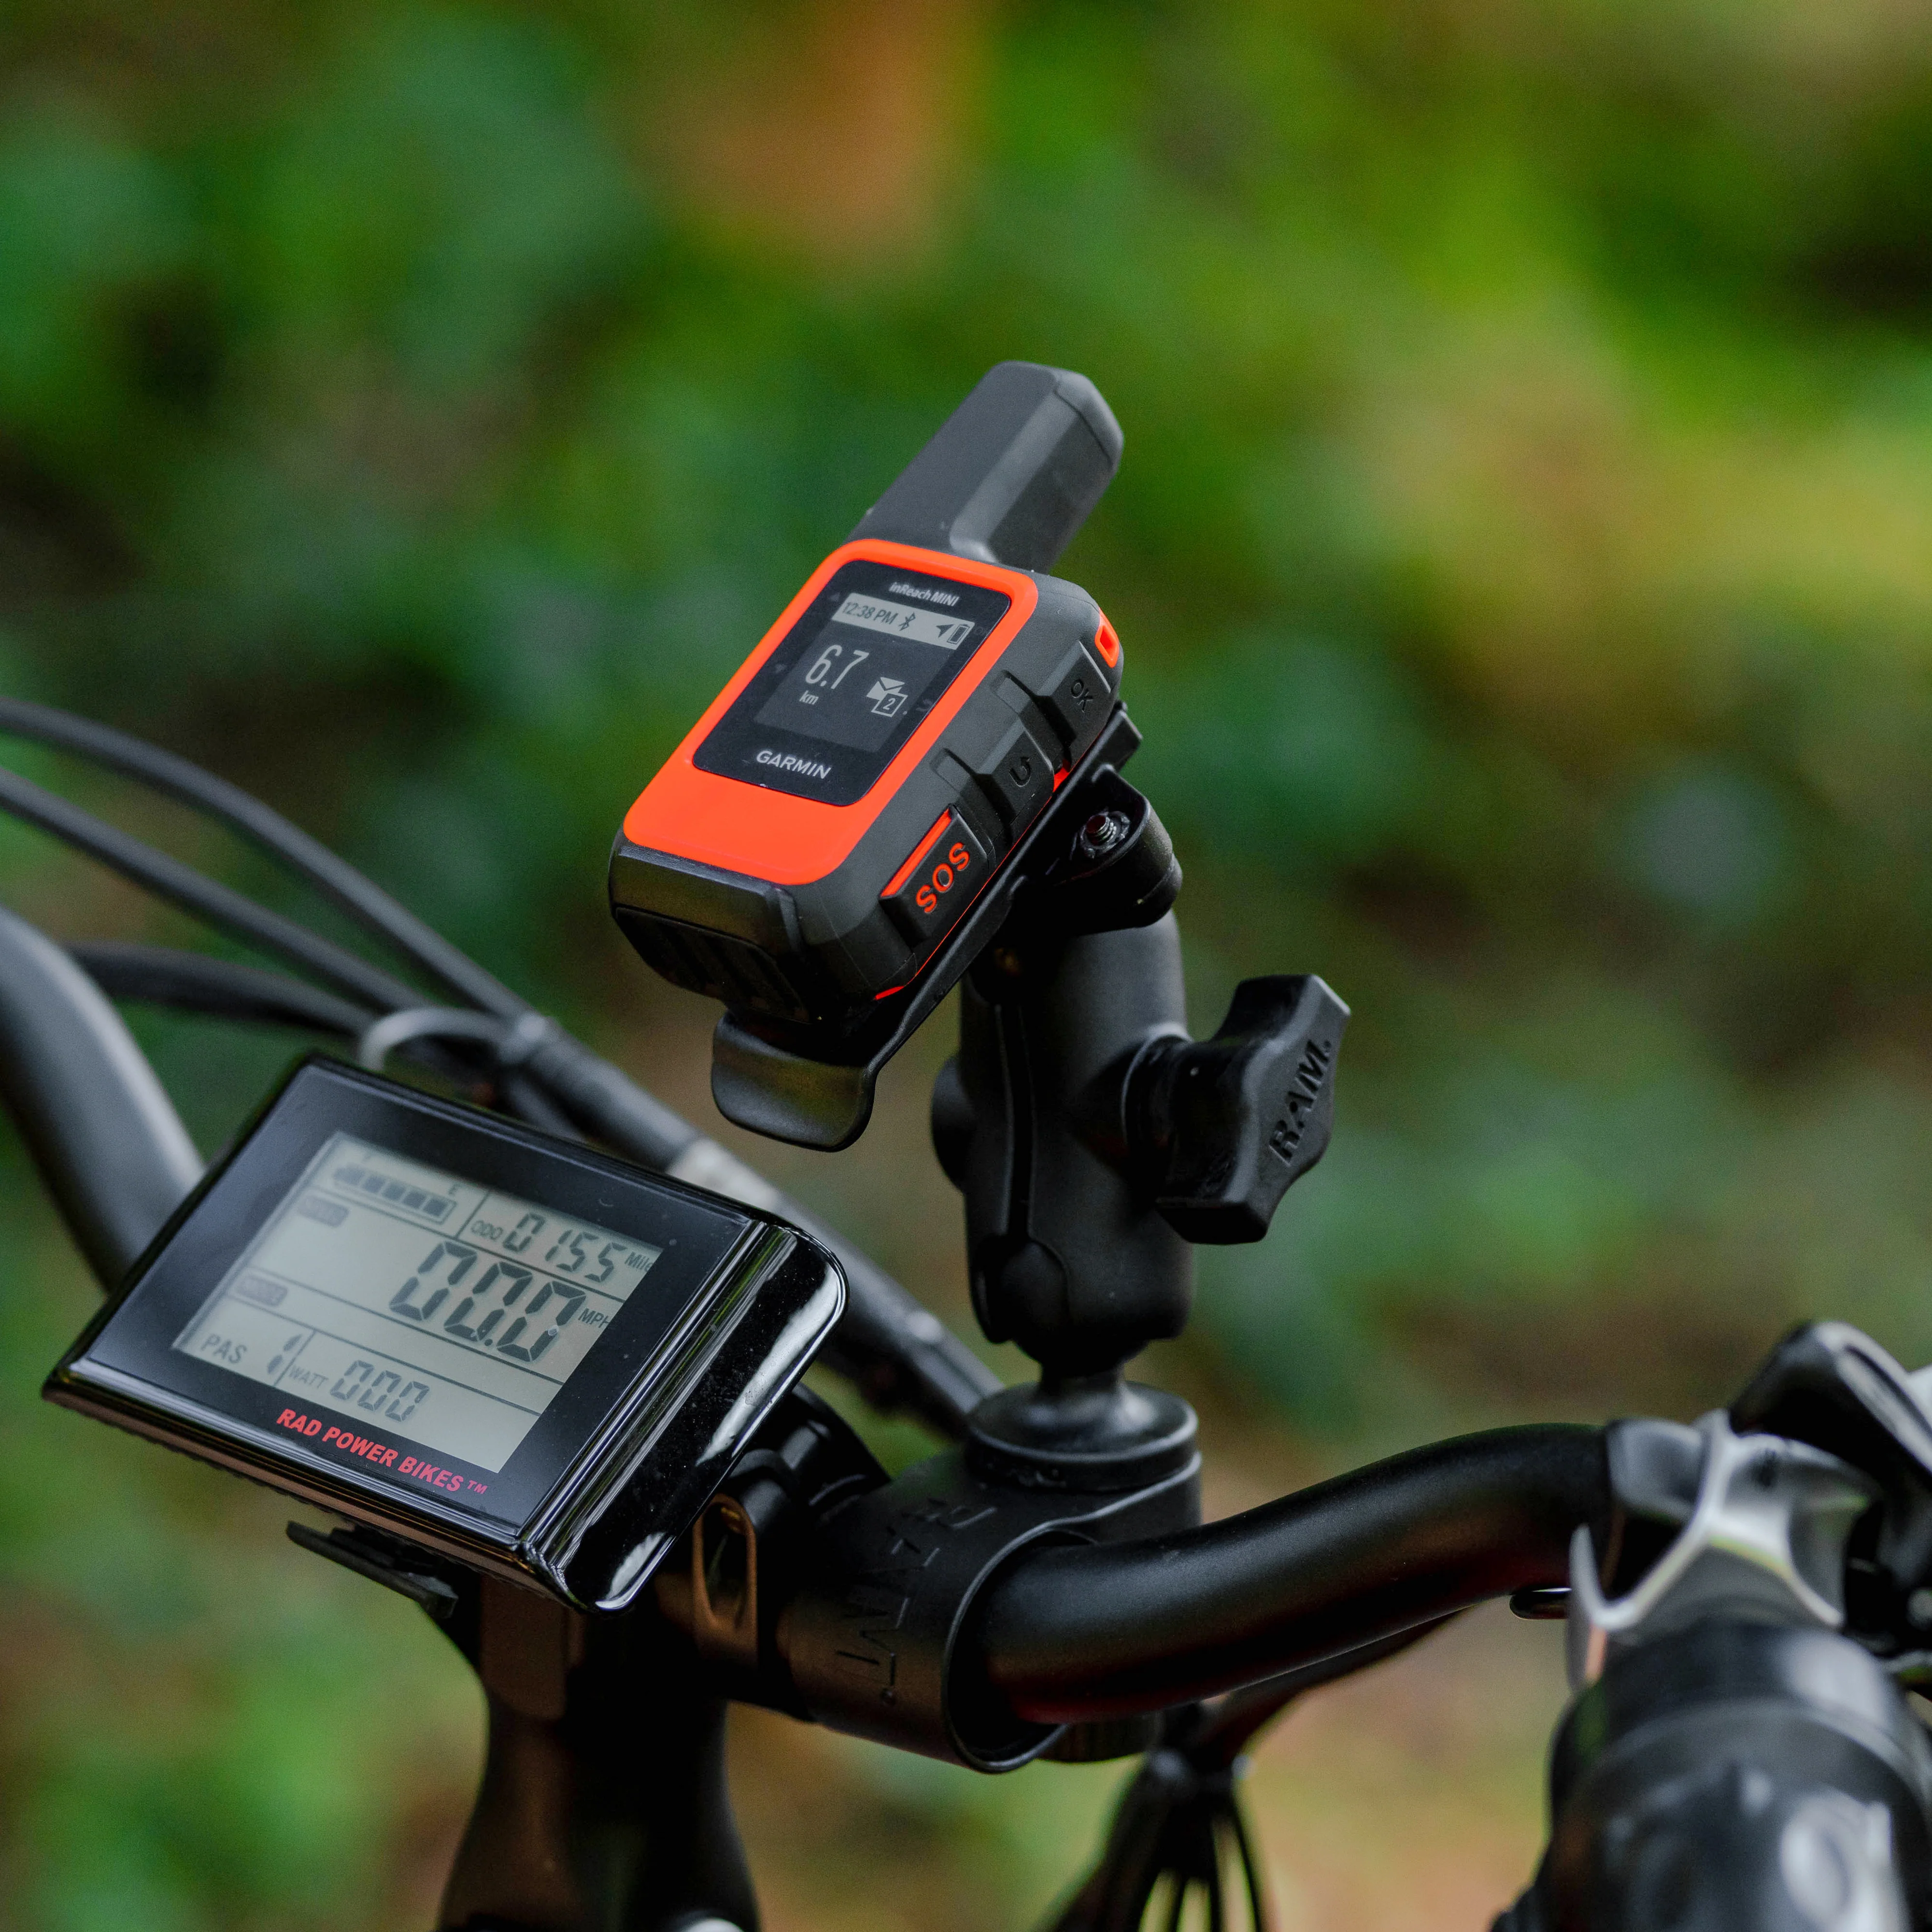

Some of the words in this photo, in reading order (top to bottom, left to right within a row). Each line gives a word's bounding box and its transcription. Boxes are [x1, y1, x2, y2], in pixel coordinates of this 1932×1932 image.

[889, 582, 931, 600] inReach
[930, 591, 959, 607] MINI
[842, 602, 875, 619] 12:38
[873, 609, 898, 625] PM
[805, 644, 869, 689] 6.7
[799, 690, 819, 705] km
[882, 697, 896, 710] 2
[1071, 679, 1094, 713] OK
[756, 750, 831, 779] GARMIN
[916, 842, 969, 913] SOS
[200, 1334, 247, 1364] PAS
[289, 1365, 329, 1389] WATT
[330, 1360, 430, 1422] 000
[276, 1408, 322, 1436] RAD
[322, 1426, 398, 1467] POWER
[398, 1456, 464, 1492] BIKES
